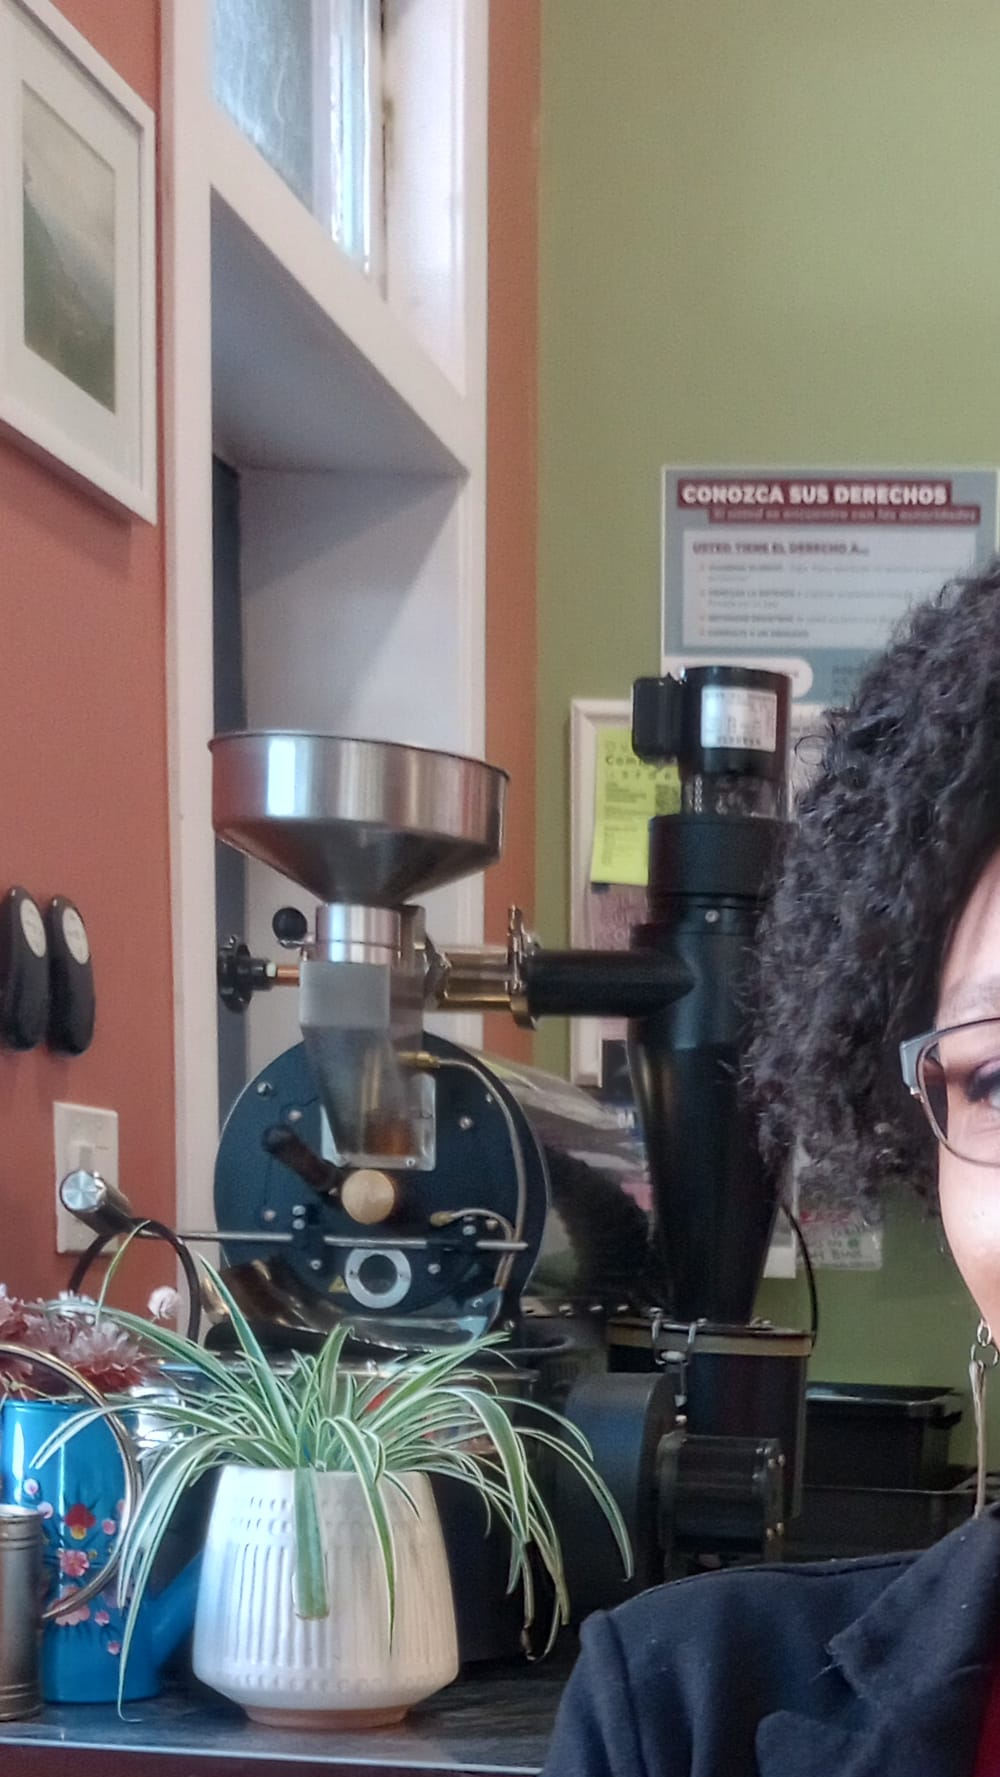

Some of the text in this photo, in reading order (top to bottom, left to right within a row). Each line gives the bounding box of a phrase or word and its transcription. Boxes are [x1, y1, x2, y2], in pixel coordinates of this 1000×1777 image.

[681, 484, 947, 505] CONOZCA SUS DERECHOS
